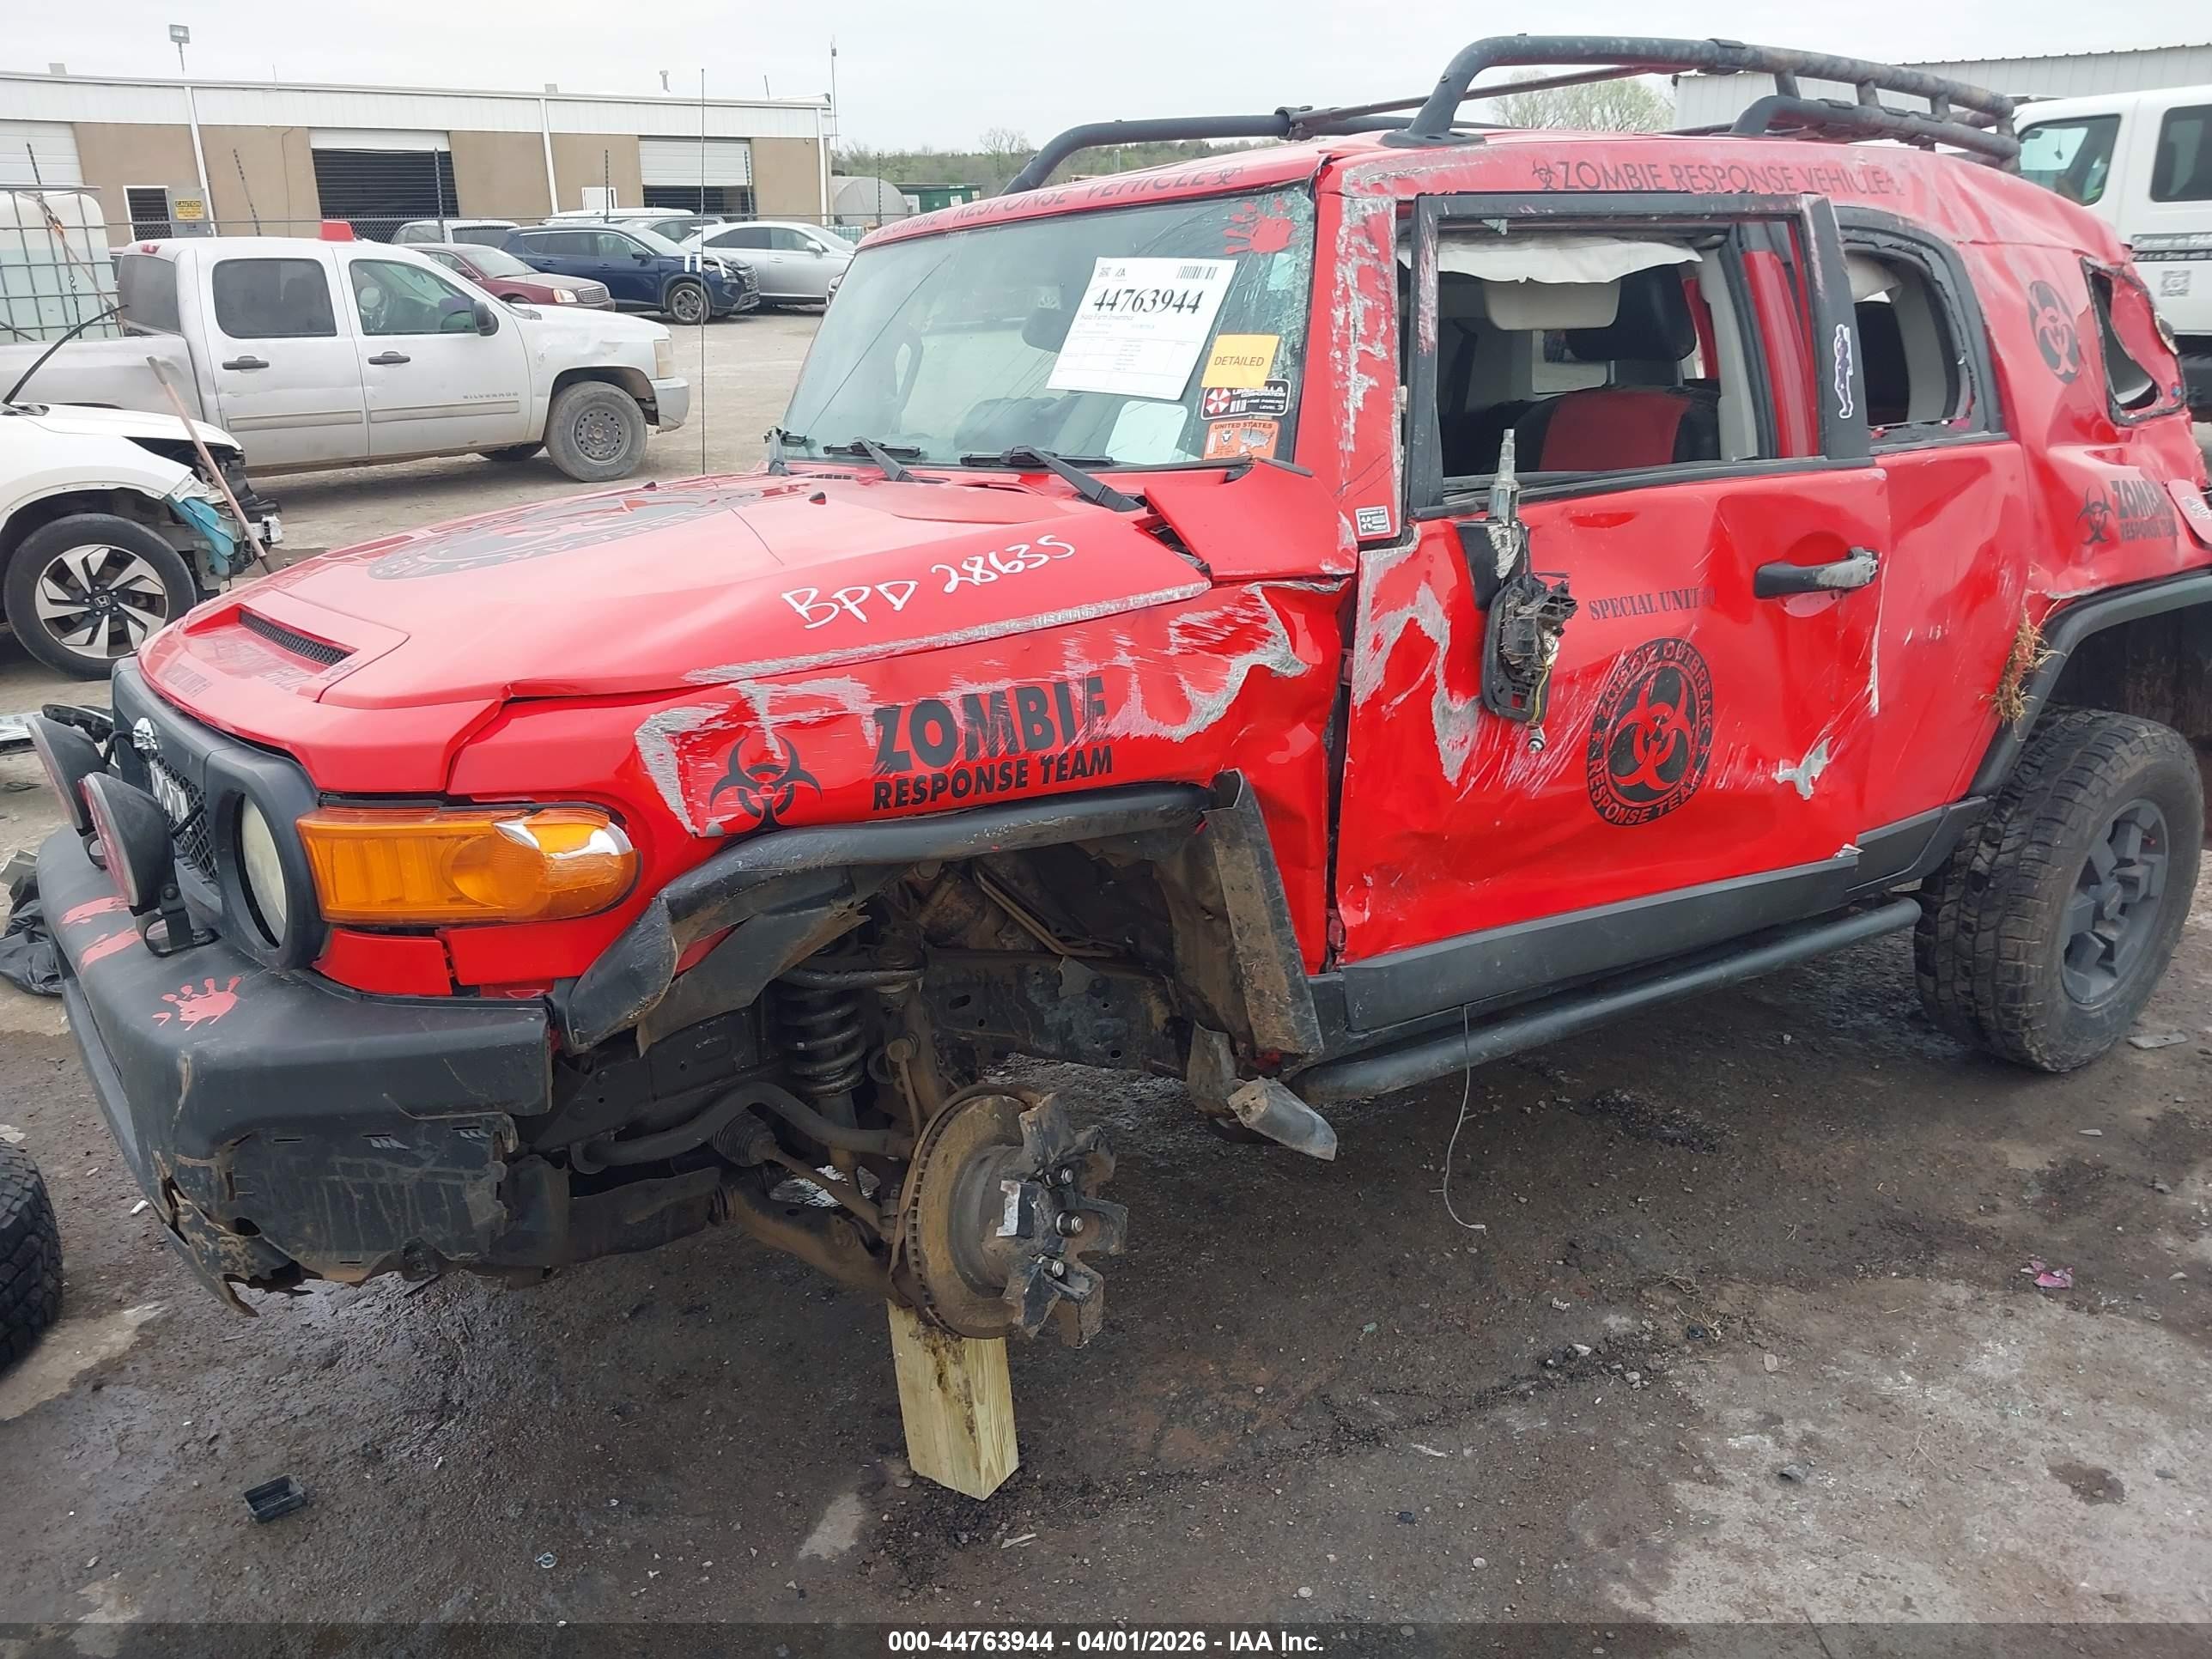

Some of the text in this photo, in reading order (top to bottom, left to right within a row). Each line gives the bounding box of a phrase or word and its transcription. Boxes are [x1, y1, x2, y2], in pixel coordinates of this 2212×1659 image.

[1556, 161, 1889, 195] ZOMBIE RESPONSE VEHICLE
[1093, 288, 1204, 314] 44763944
[1213, 356, 1265, 368] DETAILED
[1243, 421, 1273, 429] STATES
[781, 580, 920, 629] BPD
[1589, 592, 1658, 621] SPECIAL
[1658, 587, 1700, 617] UNIT
[1662, 641, 1711, 730] OUTBREAK
[872, 676, 1108, 775] ZOMBIE
[872, 744, 1114, 811] RESPONSE TEAM
[1589, 756, 1652, 825] RESPONSE
